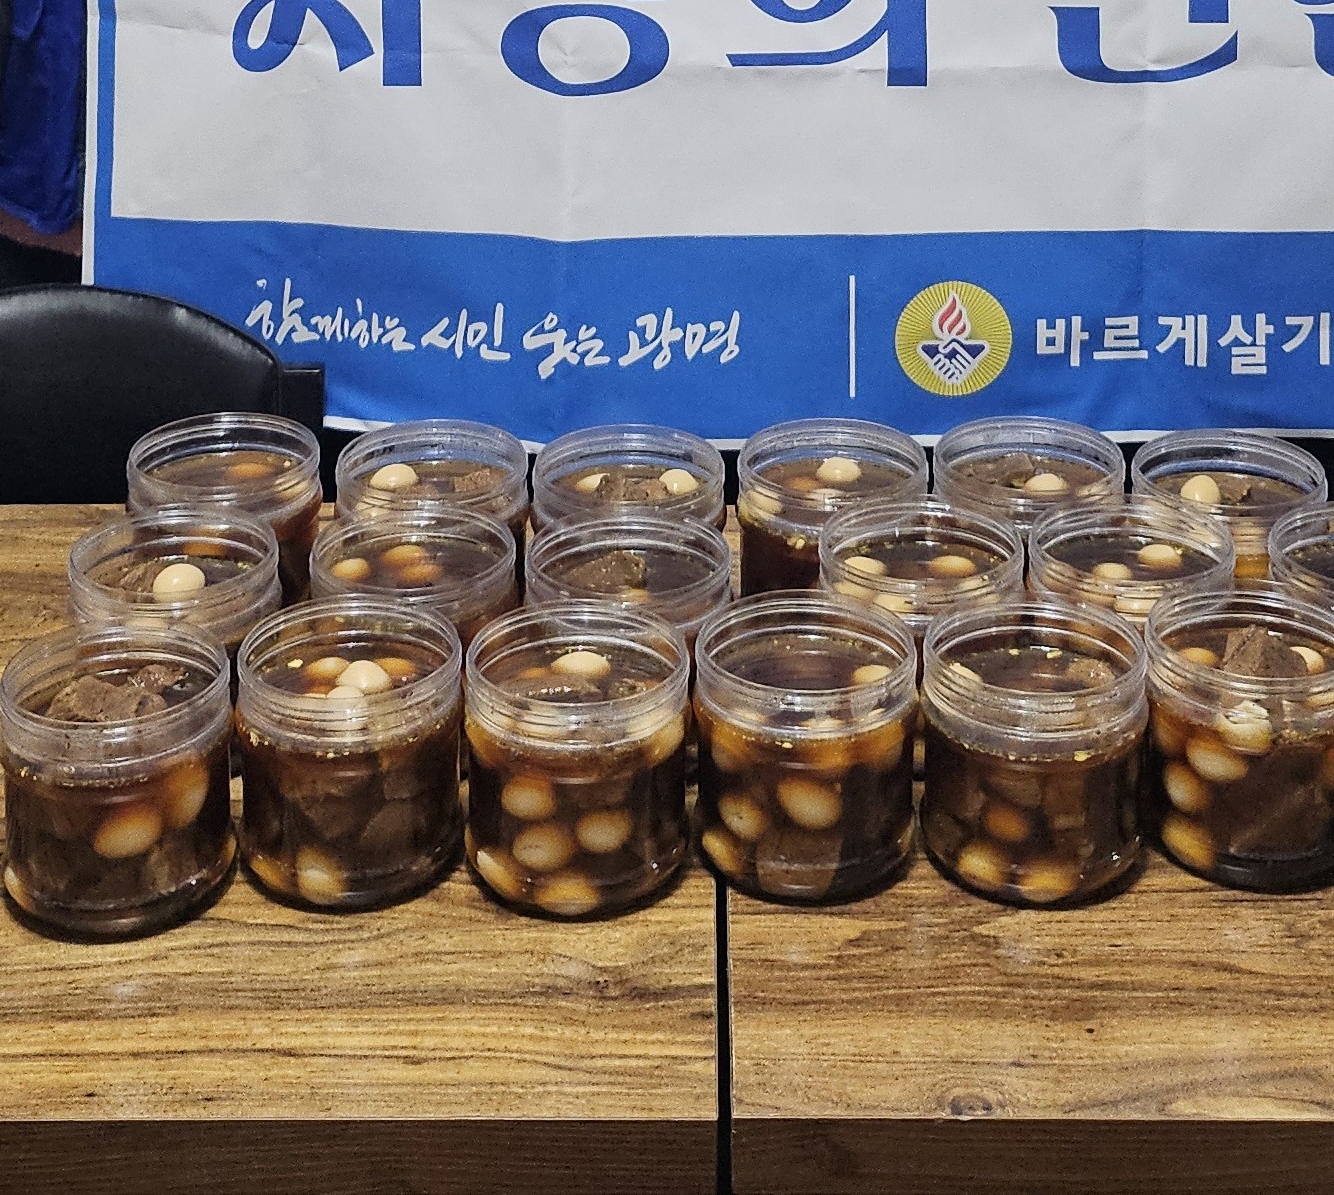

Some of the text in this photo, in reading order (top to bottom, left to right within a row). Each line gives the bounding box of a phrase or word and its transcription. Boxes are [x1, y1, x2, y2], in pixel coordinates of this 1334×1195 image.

[246, 278, 739, 379] 함께하는 시민 웃는 광명
